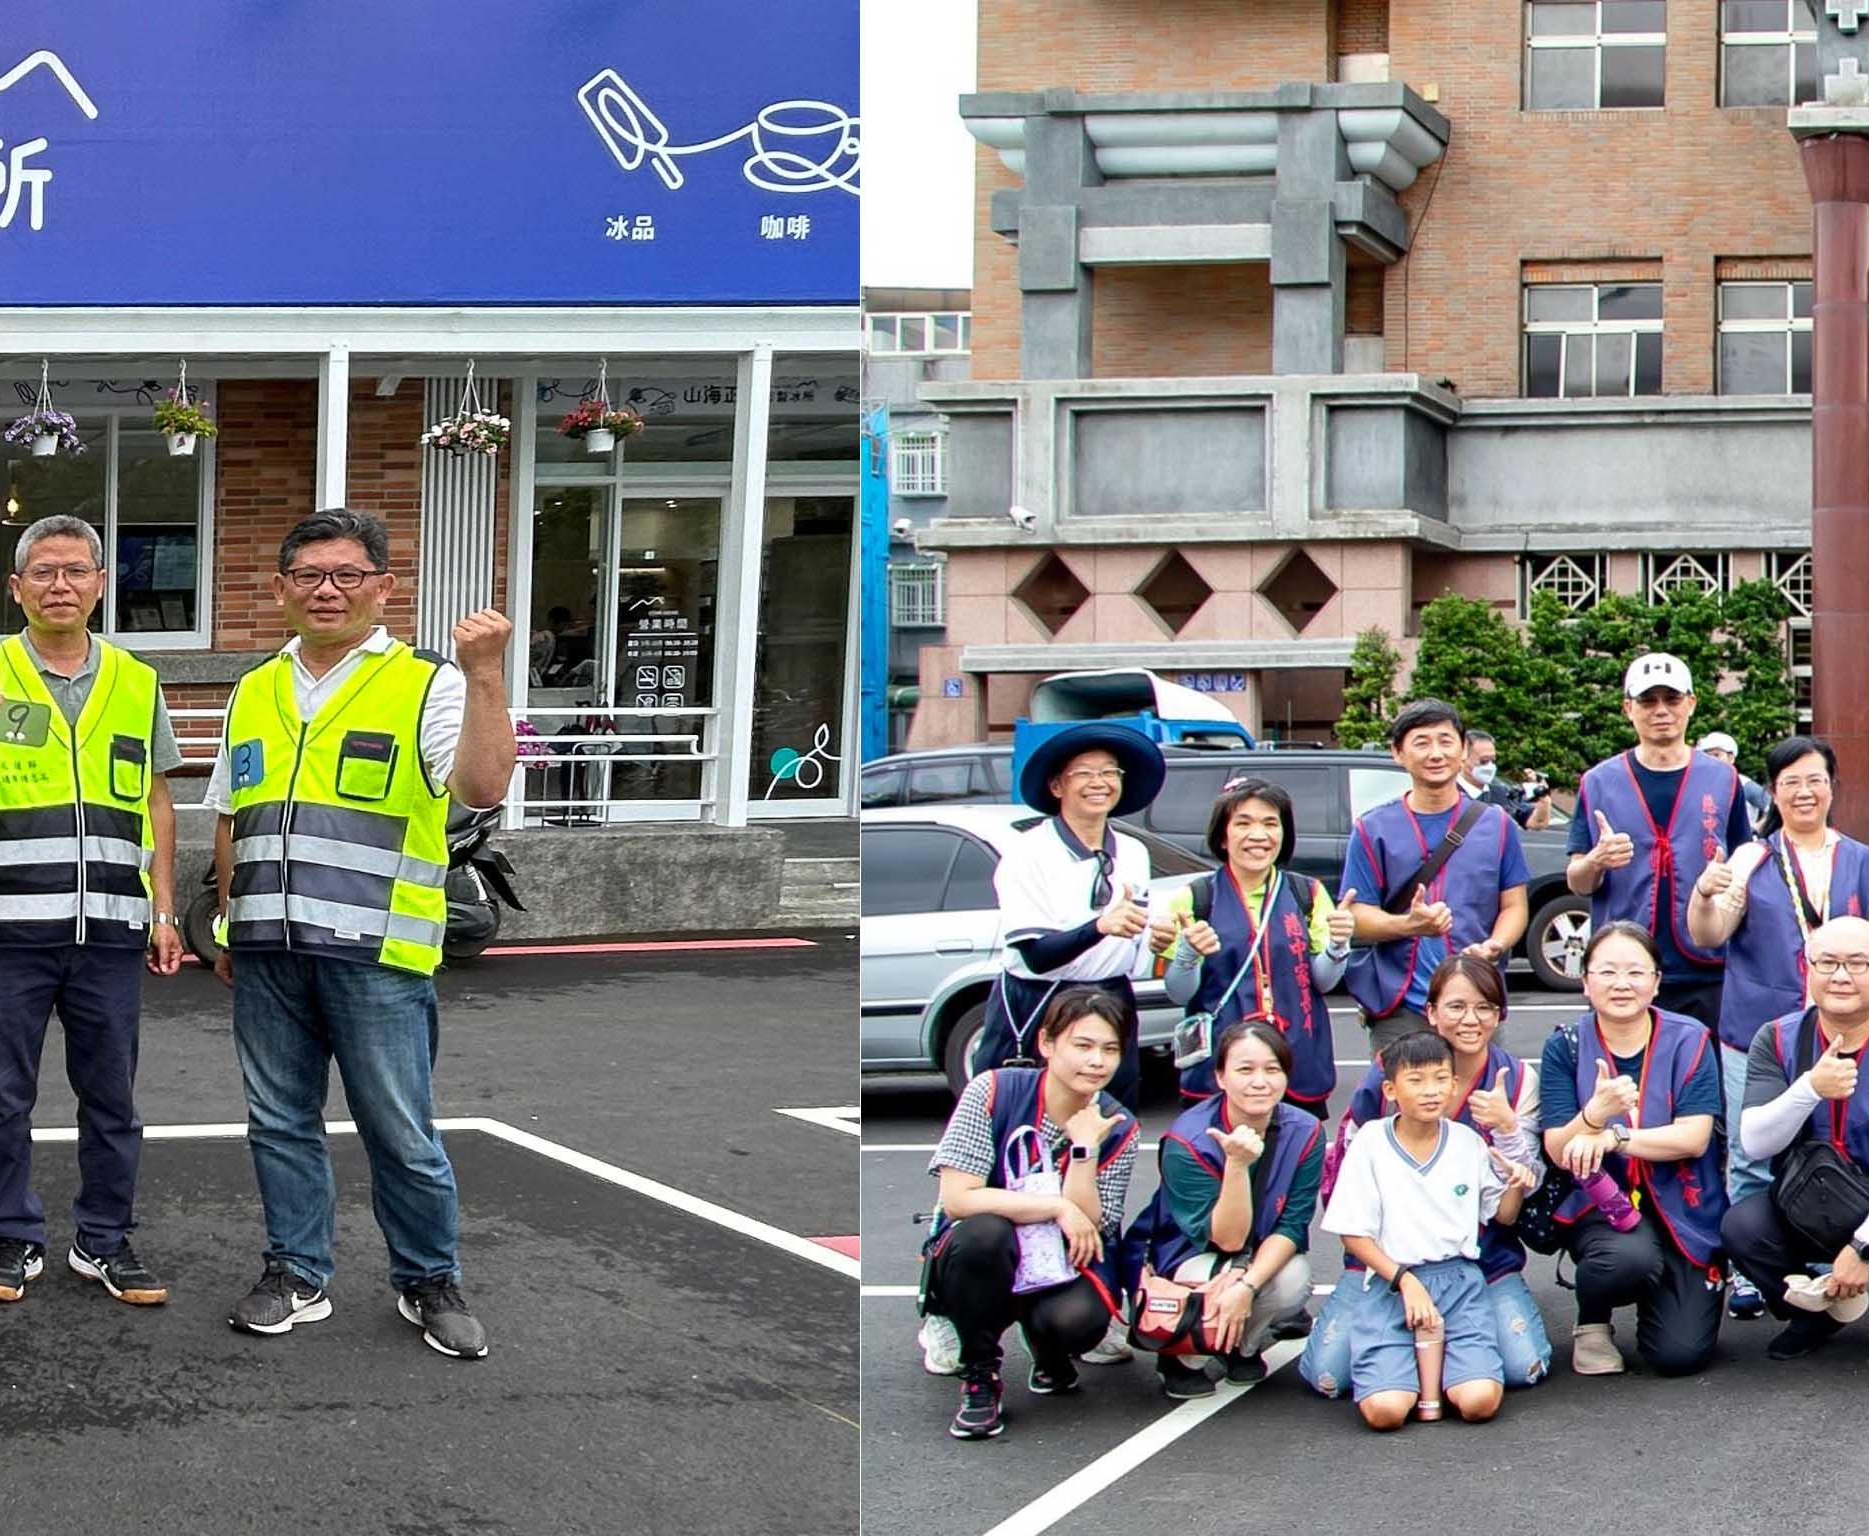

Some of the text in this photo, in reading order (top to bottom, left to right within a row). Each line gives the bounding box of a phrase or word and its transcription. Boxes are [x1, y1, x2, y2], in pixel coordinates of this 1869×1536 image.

[606, 215, 655, 241] 冰品
[761, 215, 811, 240] 咖啡
[8, 703, 30, 738] 9
